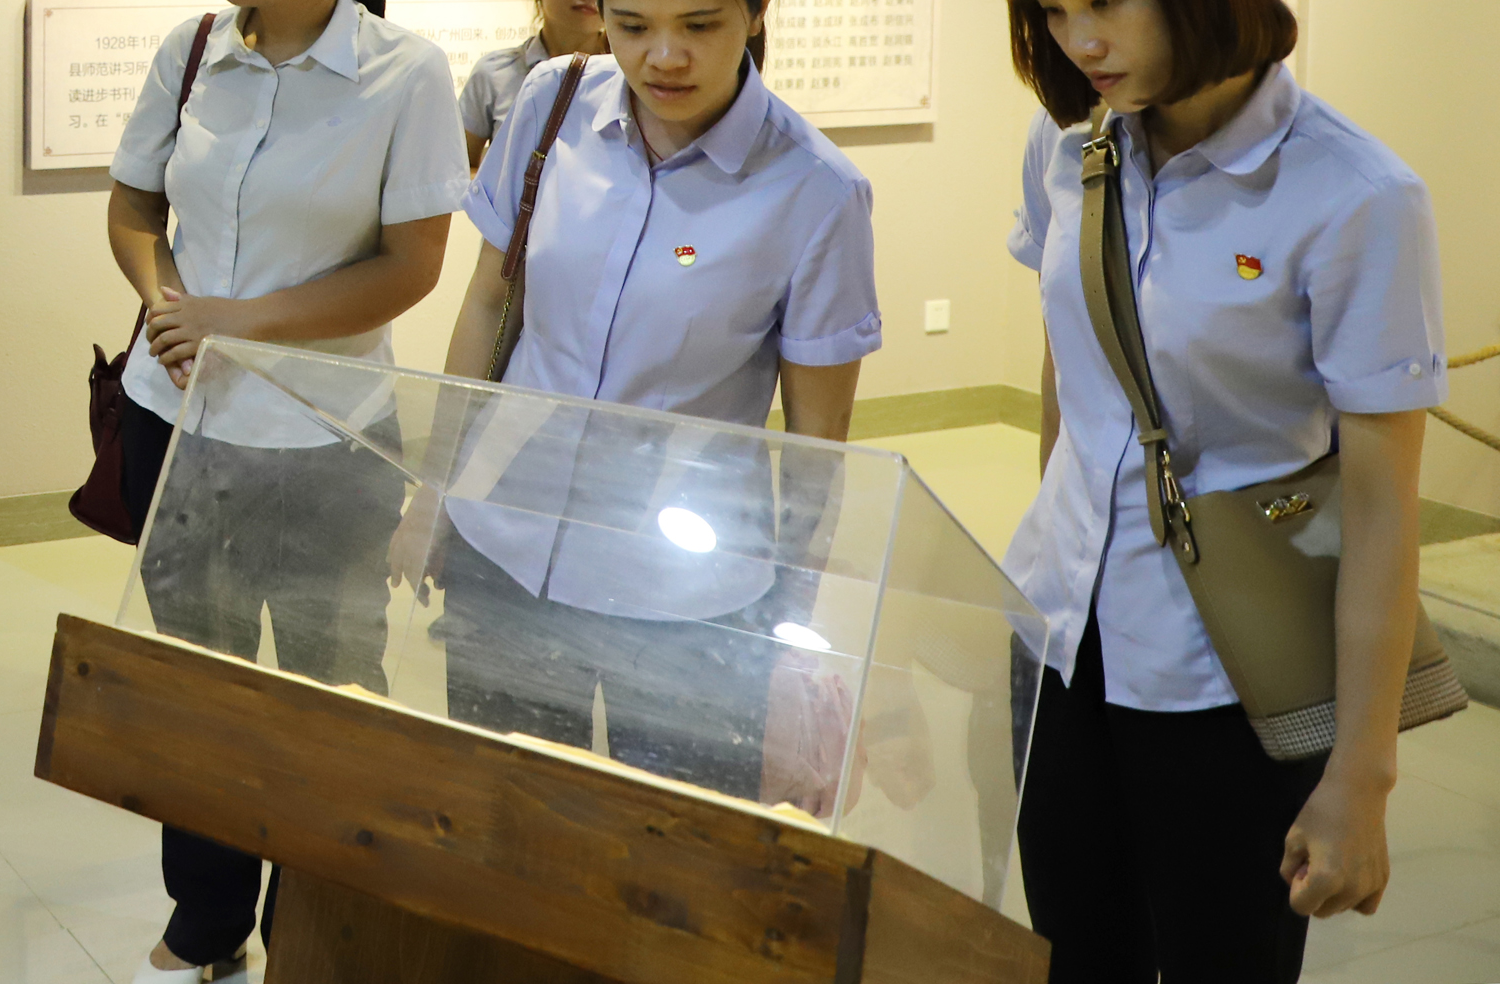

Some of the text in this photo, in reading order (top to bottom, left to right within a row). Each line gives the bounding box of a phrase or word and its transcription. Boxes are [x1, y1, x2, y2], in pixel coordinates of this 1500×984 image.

[96, 35, 160, 50] 1928年1月
[69, 62, 149, 76] 县师范讲习所
